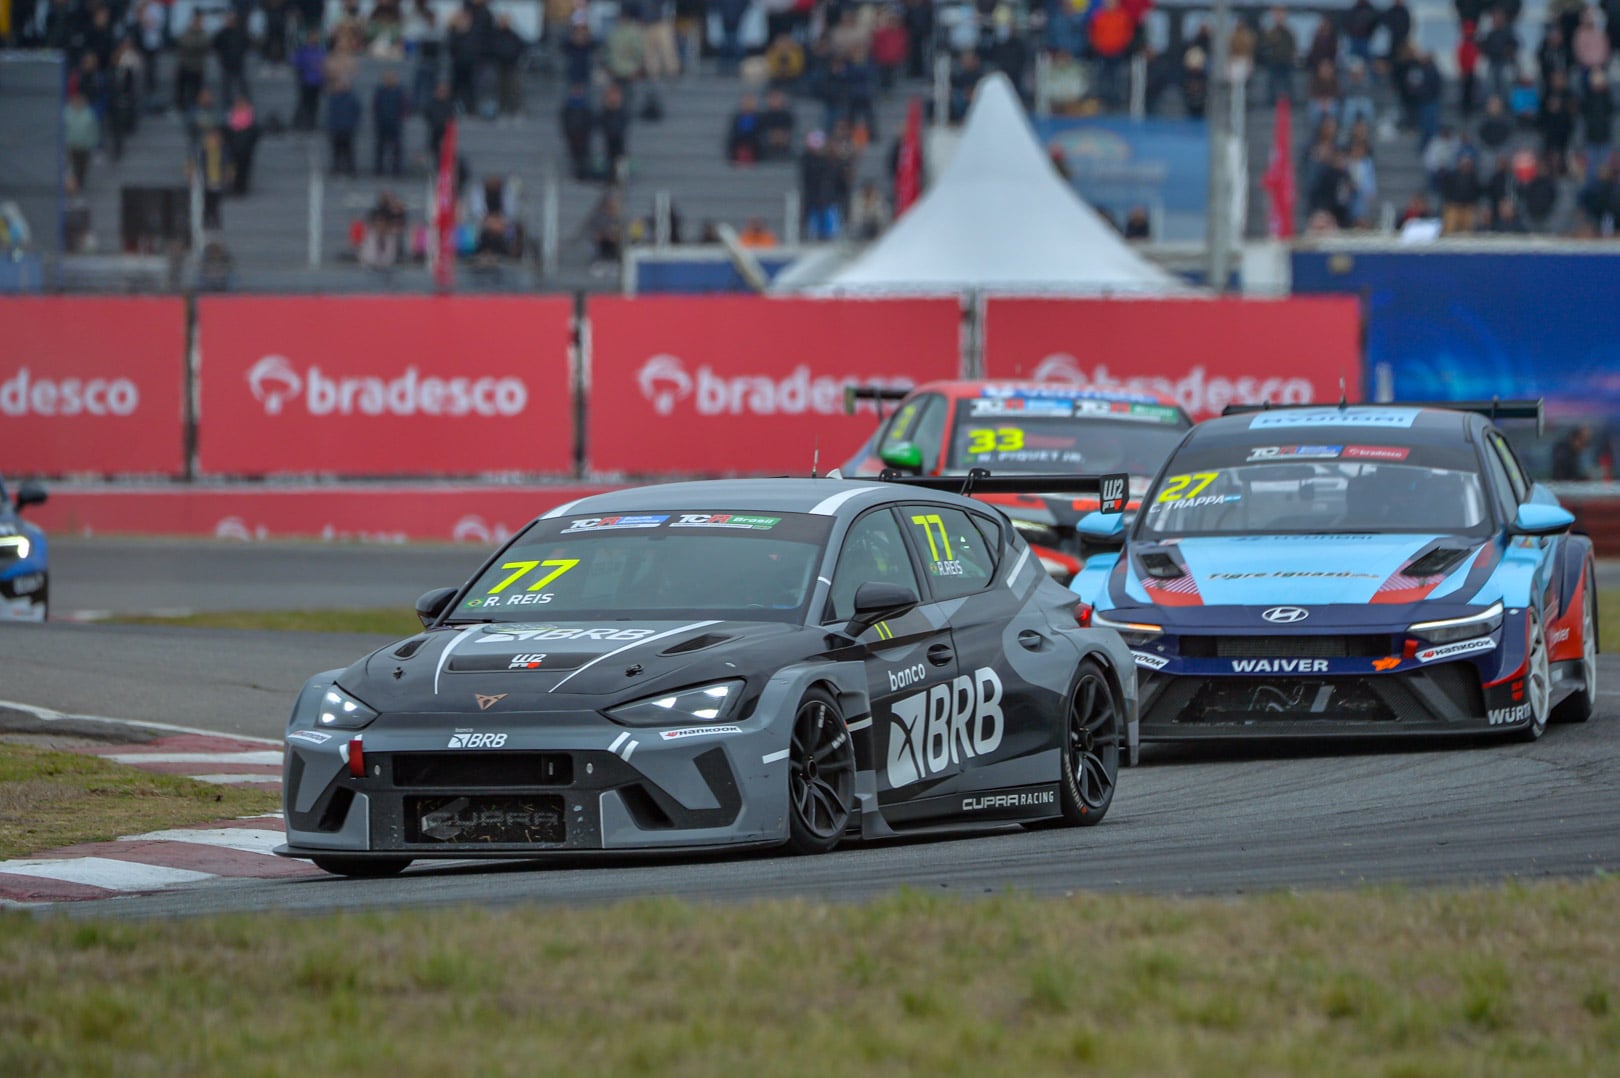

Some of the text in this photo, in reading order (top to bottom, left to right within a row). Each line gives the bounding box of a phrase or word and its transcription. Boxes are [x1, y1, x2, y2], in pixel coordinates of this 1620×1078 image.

[306, 366, 528, 416] bradesco
[967, 427, 1024, 454] 33
[1157, 472, 1219, 503] 27
[1167, 494, 1226, 511] TRAPPA
[570, 516, 622, 529] TCR
[679, 514, 733, 524] TCR
[733, 517, 774, 525] Brasil
[911, 514, 953, 562] 77
[487, 559, 580, 595] 77
[483, 594, 555, 608] R. REIS
[533, 628, 656, 641] BRB
[1231, 659, 1329, 673] WAIVER
[888, 663, 925, 691] banco
[927, 666, 1004, 773] BRB
[467, 733, 508, 748] BRB
[962, 791, 1054, 811] CUPRA RACING
